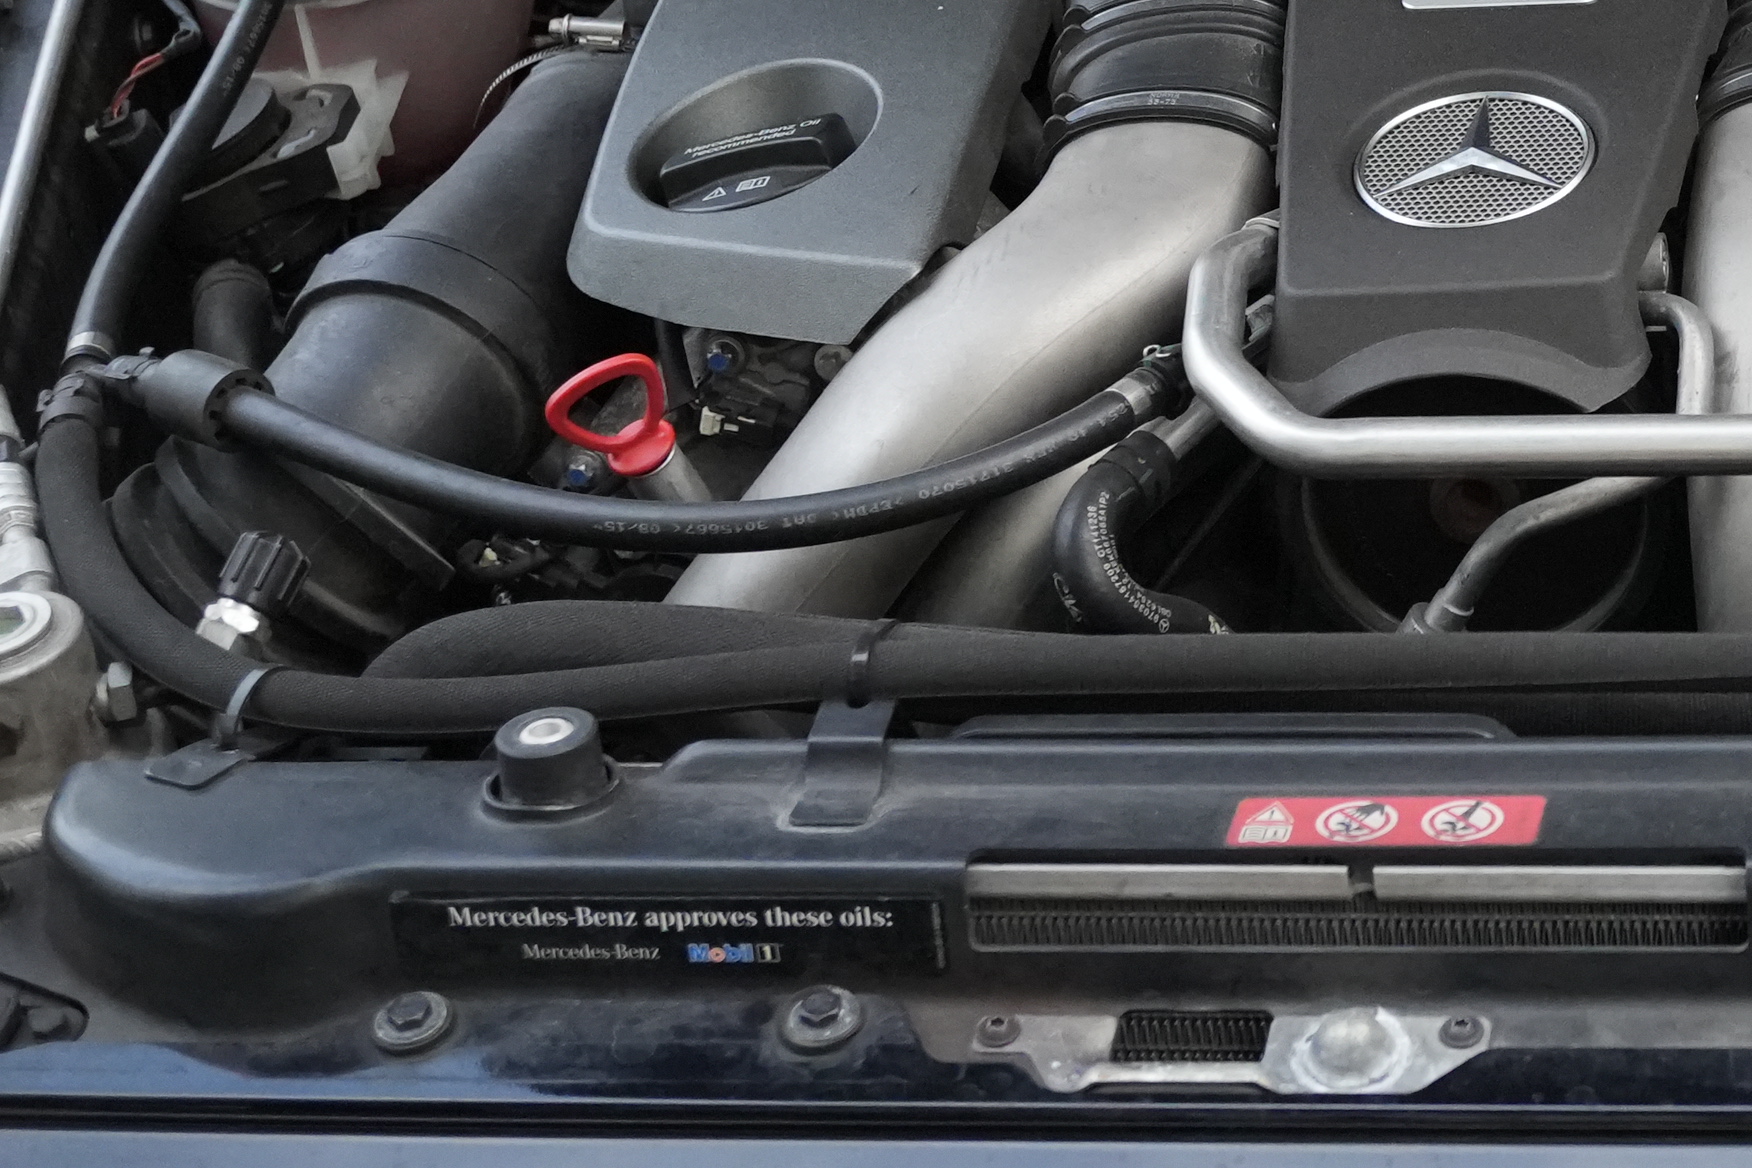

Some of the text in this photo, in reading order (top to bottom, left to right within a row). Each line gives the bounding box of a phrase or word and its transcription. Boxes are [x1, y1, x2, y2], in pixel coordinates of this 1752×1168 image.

[684, 118, 822, 155] Mercedes-Benz Oil
[692, 128, 796, 159] recommended
[447, 906, 893, 931] Mercedes-Benz approves these oils:
[521, 943, 661, 960] Mercedes-Benz
[687, 943, 754, 963] Mobil
